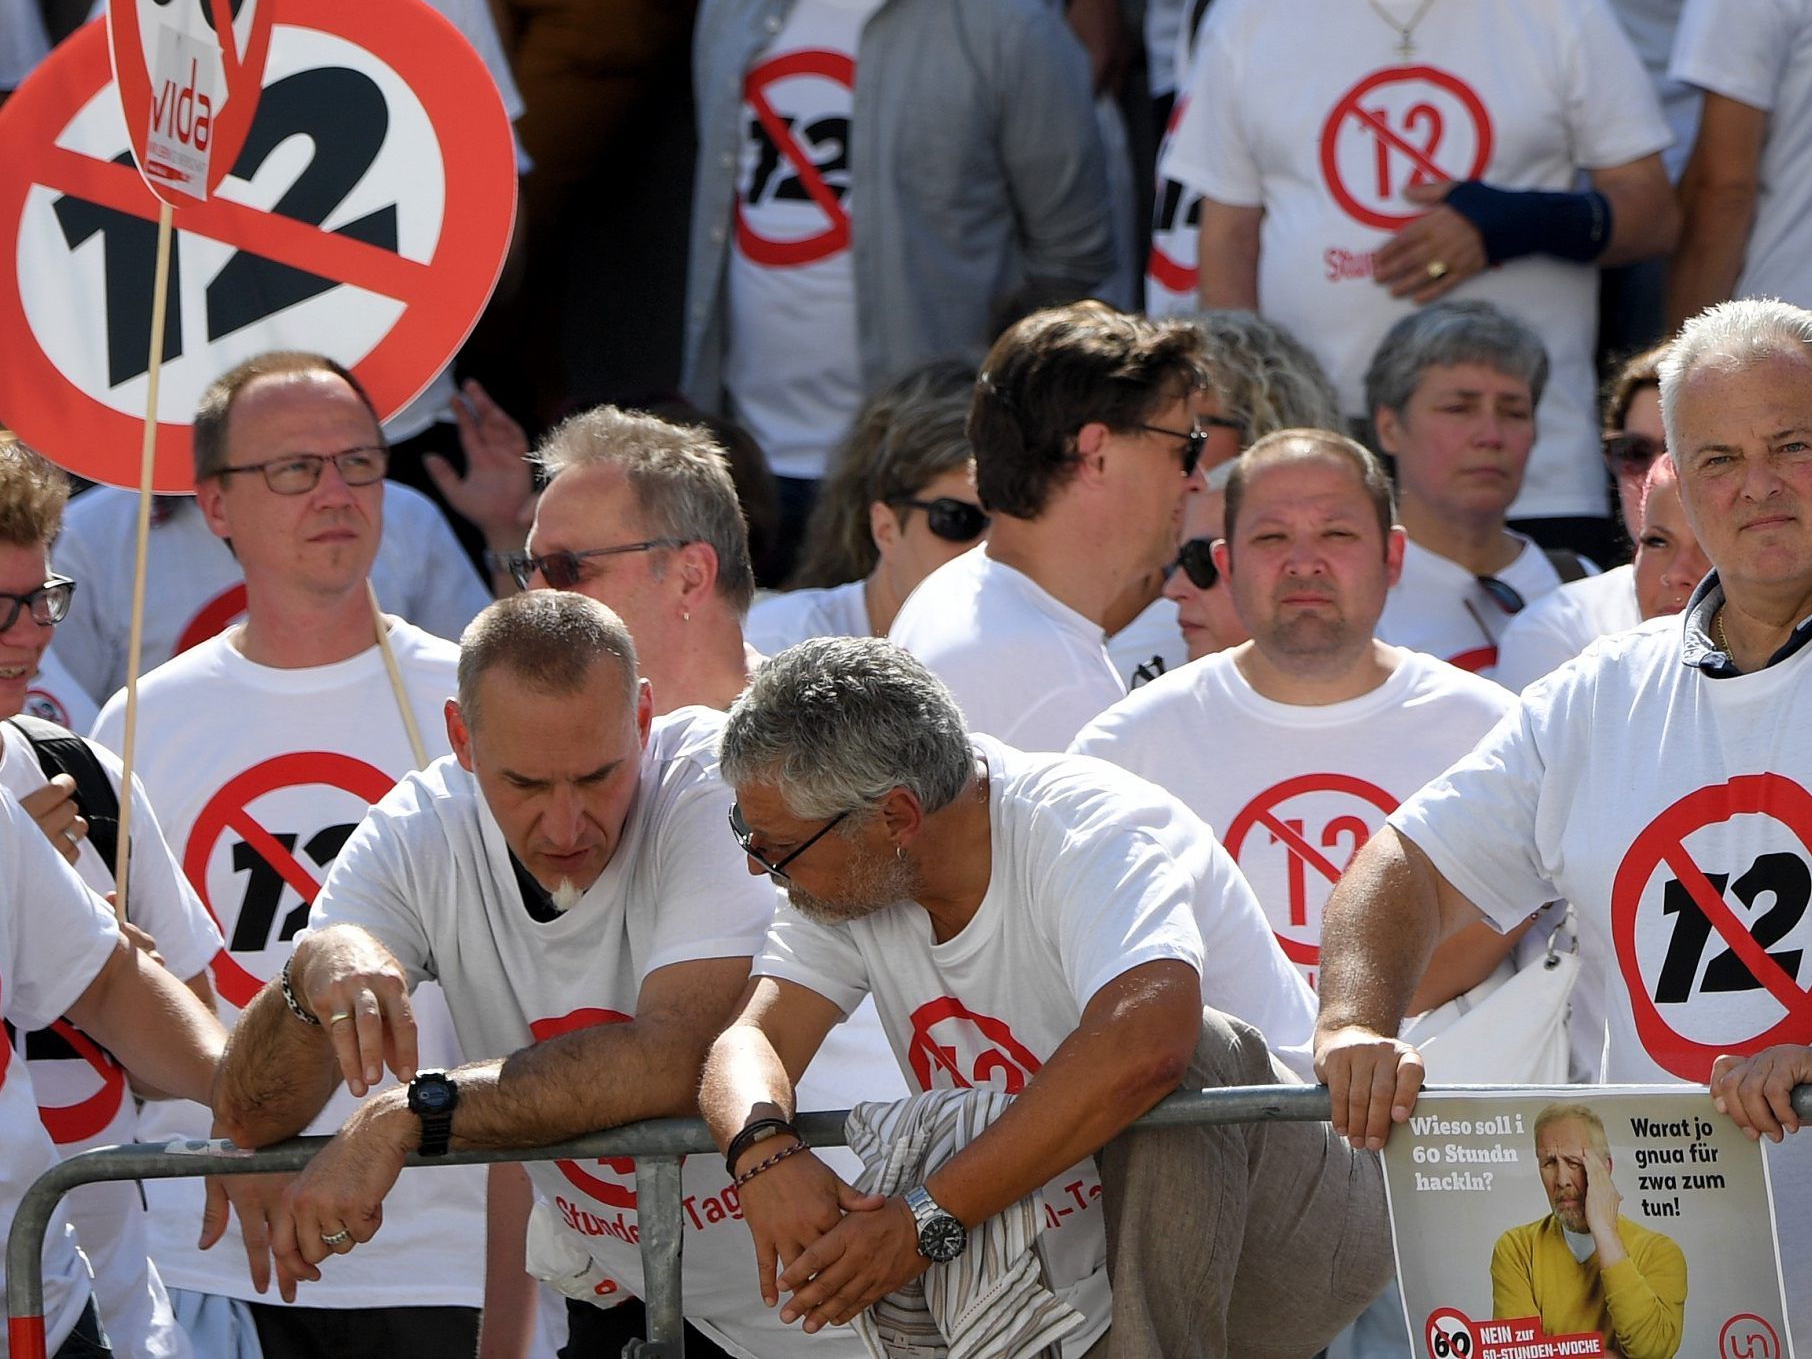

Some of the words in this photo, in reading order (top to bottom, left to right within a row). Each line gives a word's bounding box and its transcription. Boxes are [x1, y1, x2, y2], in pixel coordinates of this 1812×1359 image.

[153, 58, 212, 152] vida
[746, 111, 851, 205] 12
[1360, 103, 1447, 199] 12
[52, 68, 399, 389] 12
[1654, 851, 1812, 1004] 12
[1408, 1114, 1472, 1136] Wieso
[1475, 1115, 1512, 1135] soll
[1515, 1113, 1525, 1134] i
[1630, 1117, 1691, 1138] Warat
[1693, 1116, 1713, 1141] jo
[1412, 1145, 1441, 1164] 60
[1444, 1143, 1519, 1163] Stundn
[1635, 1148, 1685, 1169] gnua
[1689, 1142, 1718, 1163] für
[1414, 1171, 1494, 1191] hackln?
[1638, 1174, 1677, 1190] zwa
[1681, 1173, 1726, 1190] zum
[1641, 1196, 1681, 1217] tun!
[1433, 1330, 1472, 1358] 60
[1479, 1326, 1513, 1346] NEIN
[1514, 1327, 1536, 1342] zur
[1482, 1338, 1601, 1359] 60-STUNDEN-WOCHE
